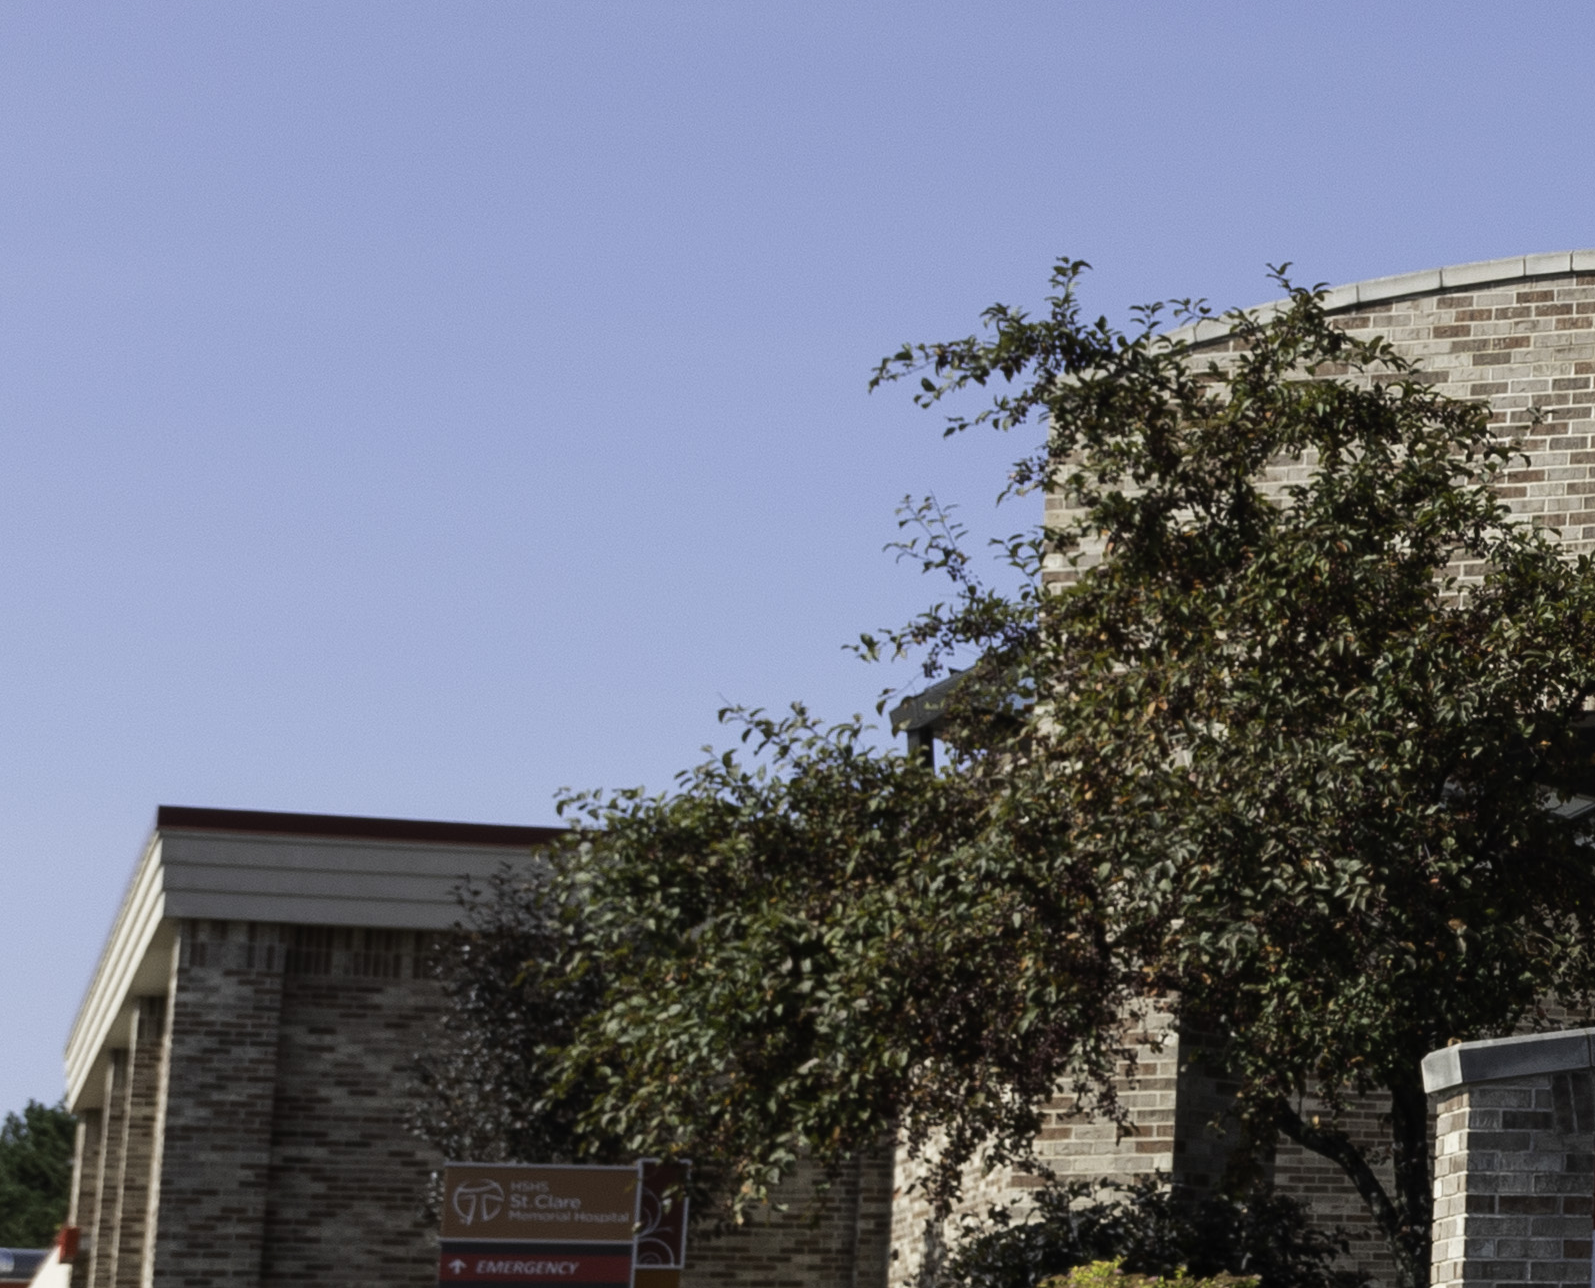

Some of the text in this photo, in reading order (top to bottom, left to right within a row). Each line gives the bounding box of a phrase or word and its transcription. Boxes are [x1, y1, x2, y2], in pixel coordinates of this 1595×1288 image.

[510, 1180, 549, 1192] HSHS
[535, 1194, 582, 1210] Clare
[508, 1210, 630, 1224] Memorial Hospital
[475, 1260, 581, 1275] EMERGENCY
